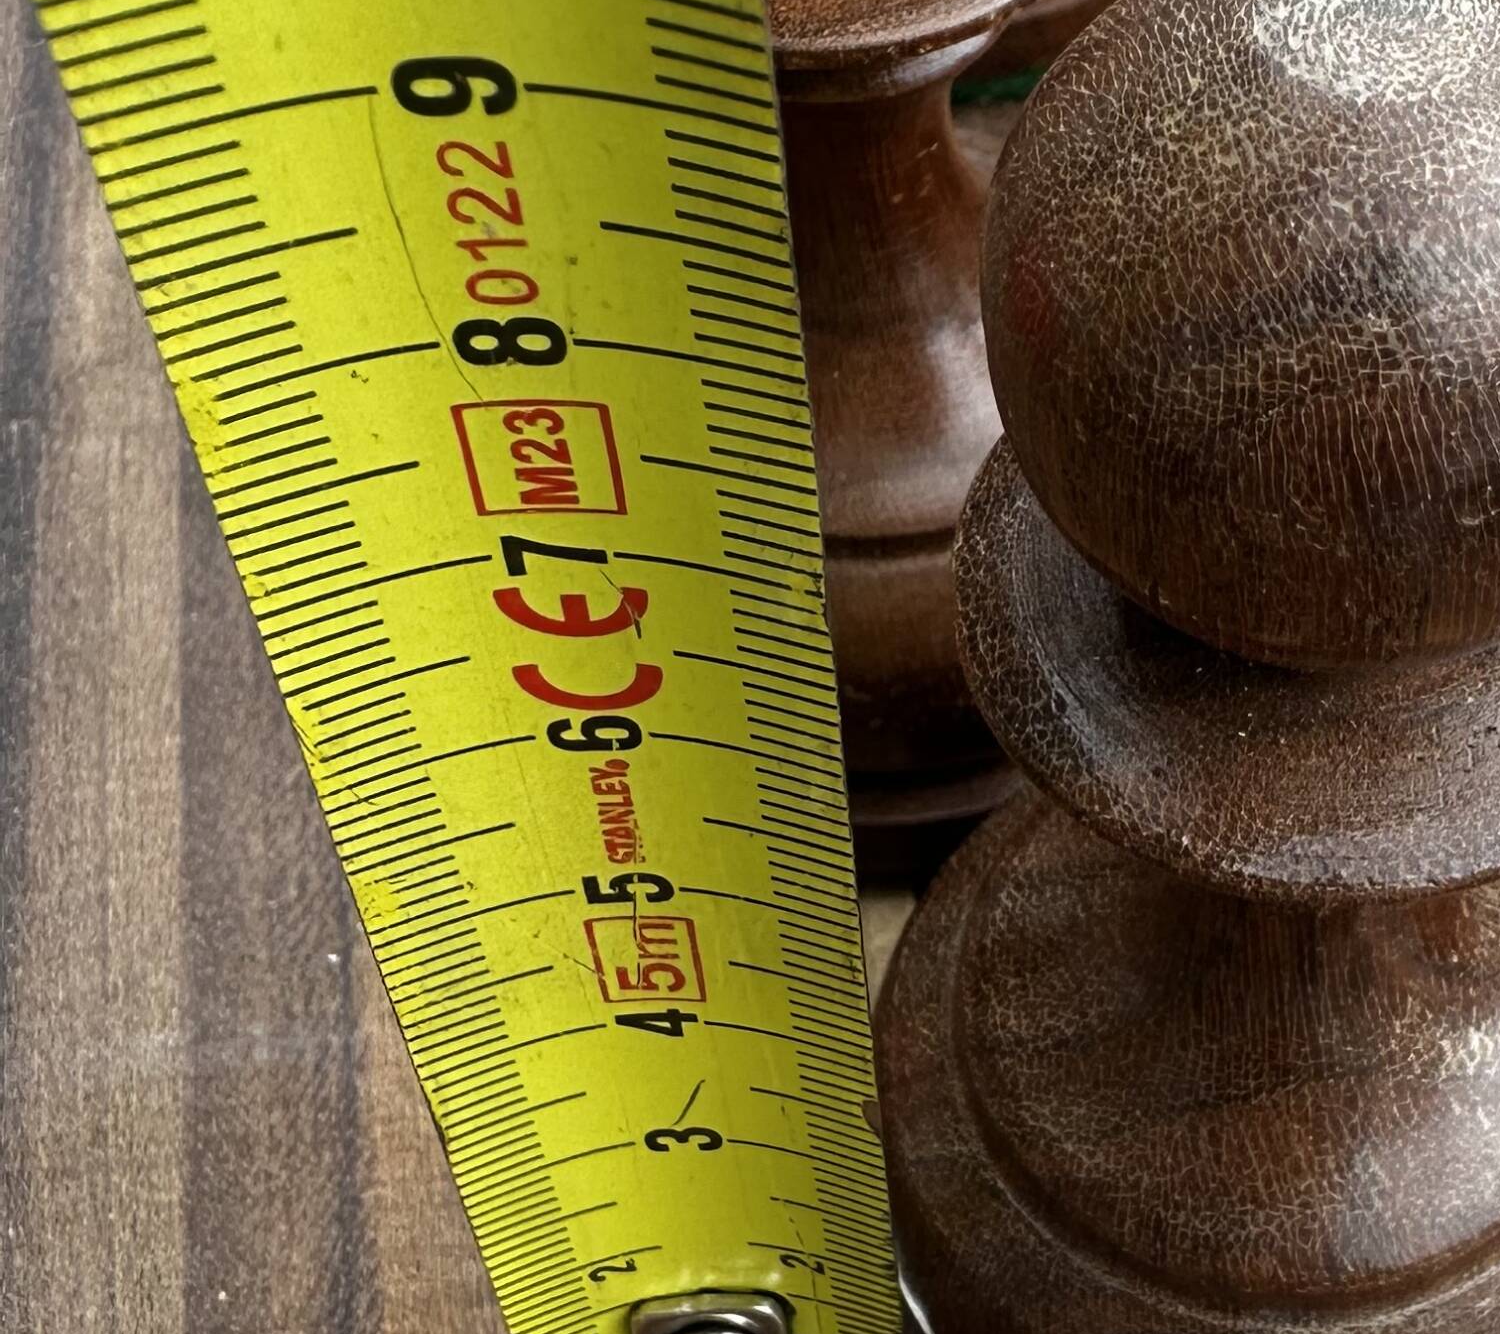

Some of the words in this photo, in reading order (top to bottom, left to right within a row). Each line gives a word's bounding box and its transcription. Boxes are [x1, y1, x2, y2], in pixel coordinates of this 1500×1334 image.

[390, 55, 518, 117] 9
[435, 141, 540, 306] 0122
[452, 317, 569, 367] 8
[503, 407, 580, 506] M23
[500, 535, 609, 576] 7
[546, 715, 643, 752] 6
[588, 763, 637, 864] STANLEY
[582, 872, 675, 904] 5
[616, 922, 685, 993] 5m
[615, 1008, 698, 1037] 4
[645, 1126, 723, 1152] 3
